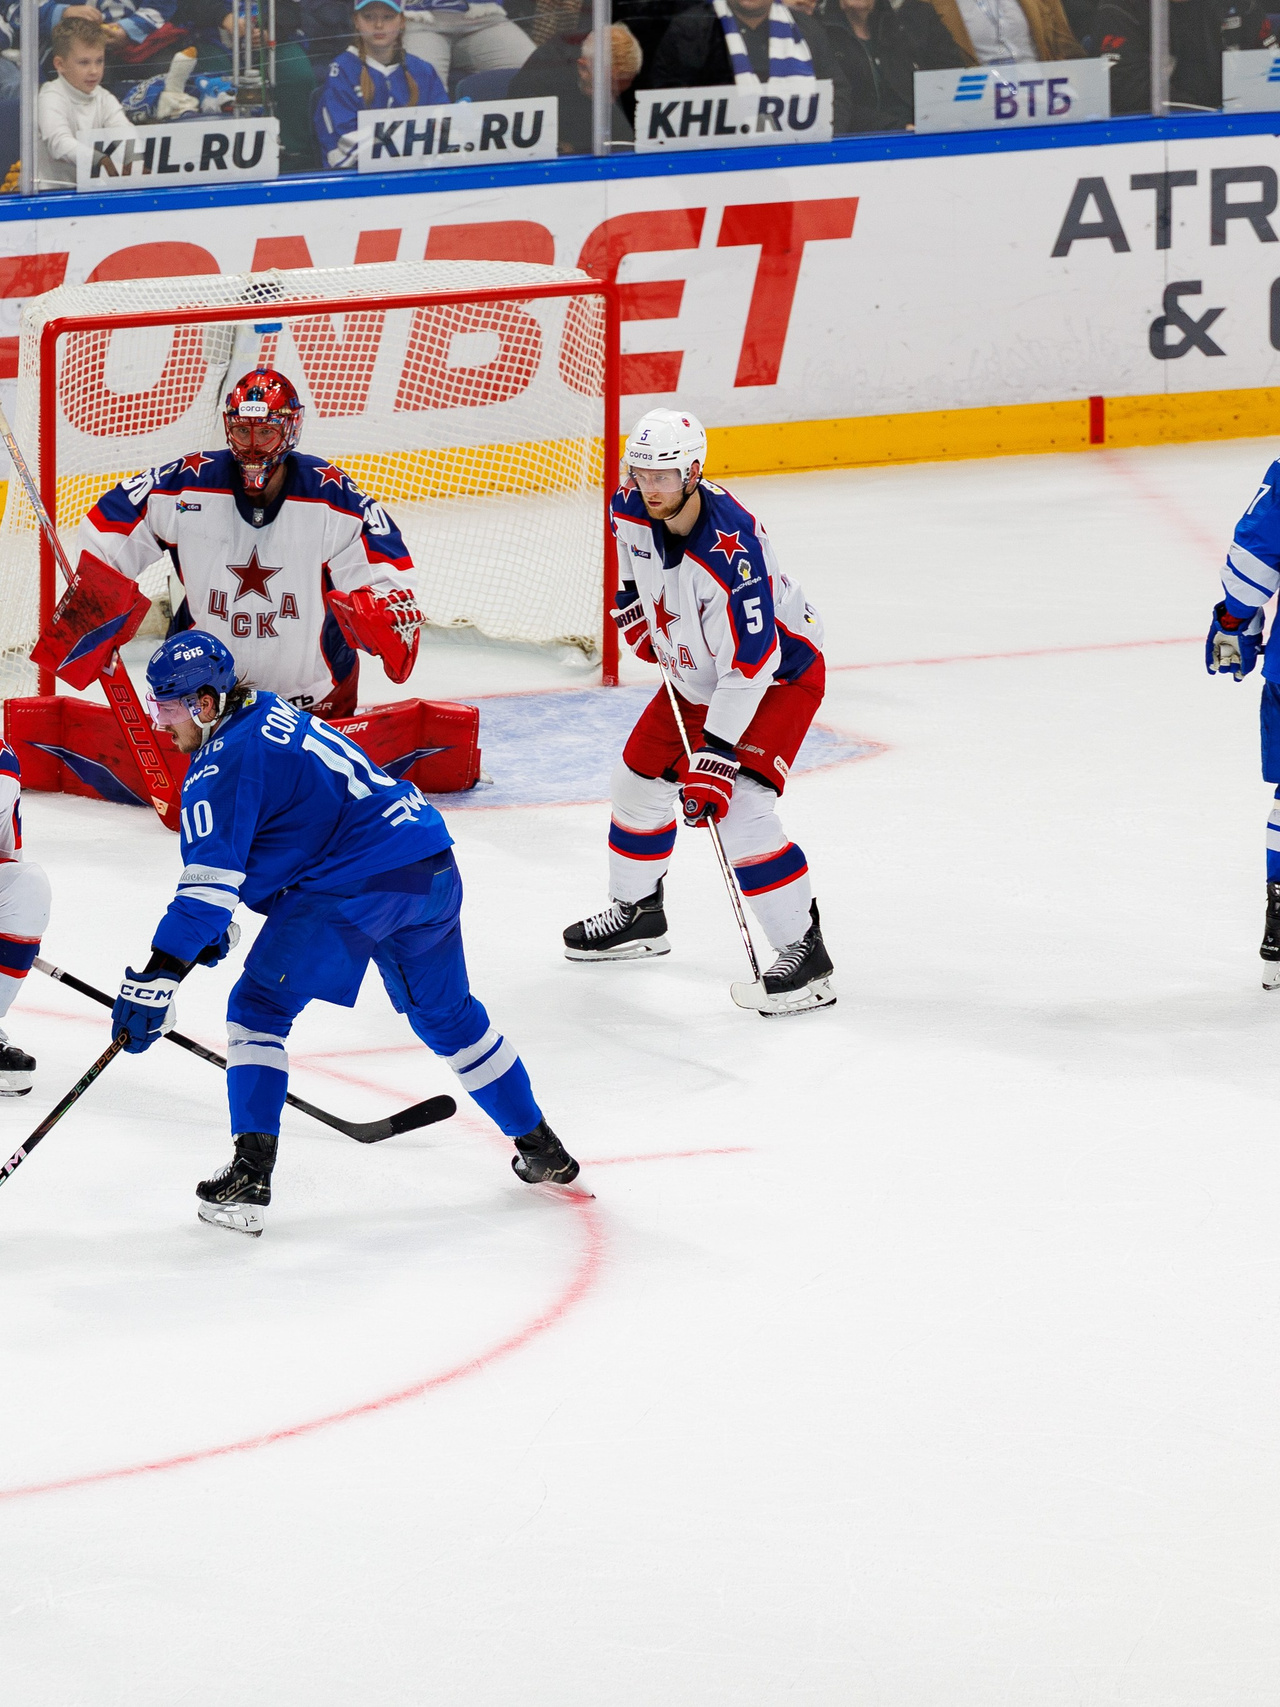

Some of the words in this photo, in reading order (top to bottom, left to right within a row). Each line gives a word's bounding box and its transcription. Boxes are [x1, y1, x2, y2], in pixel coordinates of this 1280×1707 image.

[648, 93, 820, 139] KHL.RU
[993, 77, 1072, 120] ВТБ
[90, 130, 265, 178] KHL.RU
[371, 110, 544, 160] KHL.RU
[207, 588, 300, 638] ЦСКА
[742, 596, 764, 635] 5
[181, 800, 214, 844] 10
[120, 983, 174, 1001] CCM
[70, 1031, 128, 1101] JETSPEED
[216, 1174, 249, 1202] CCM
